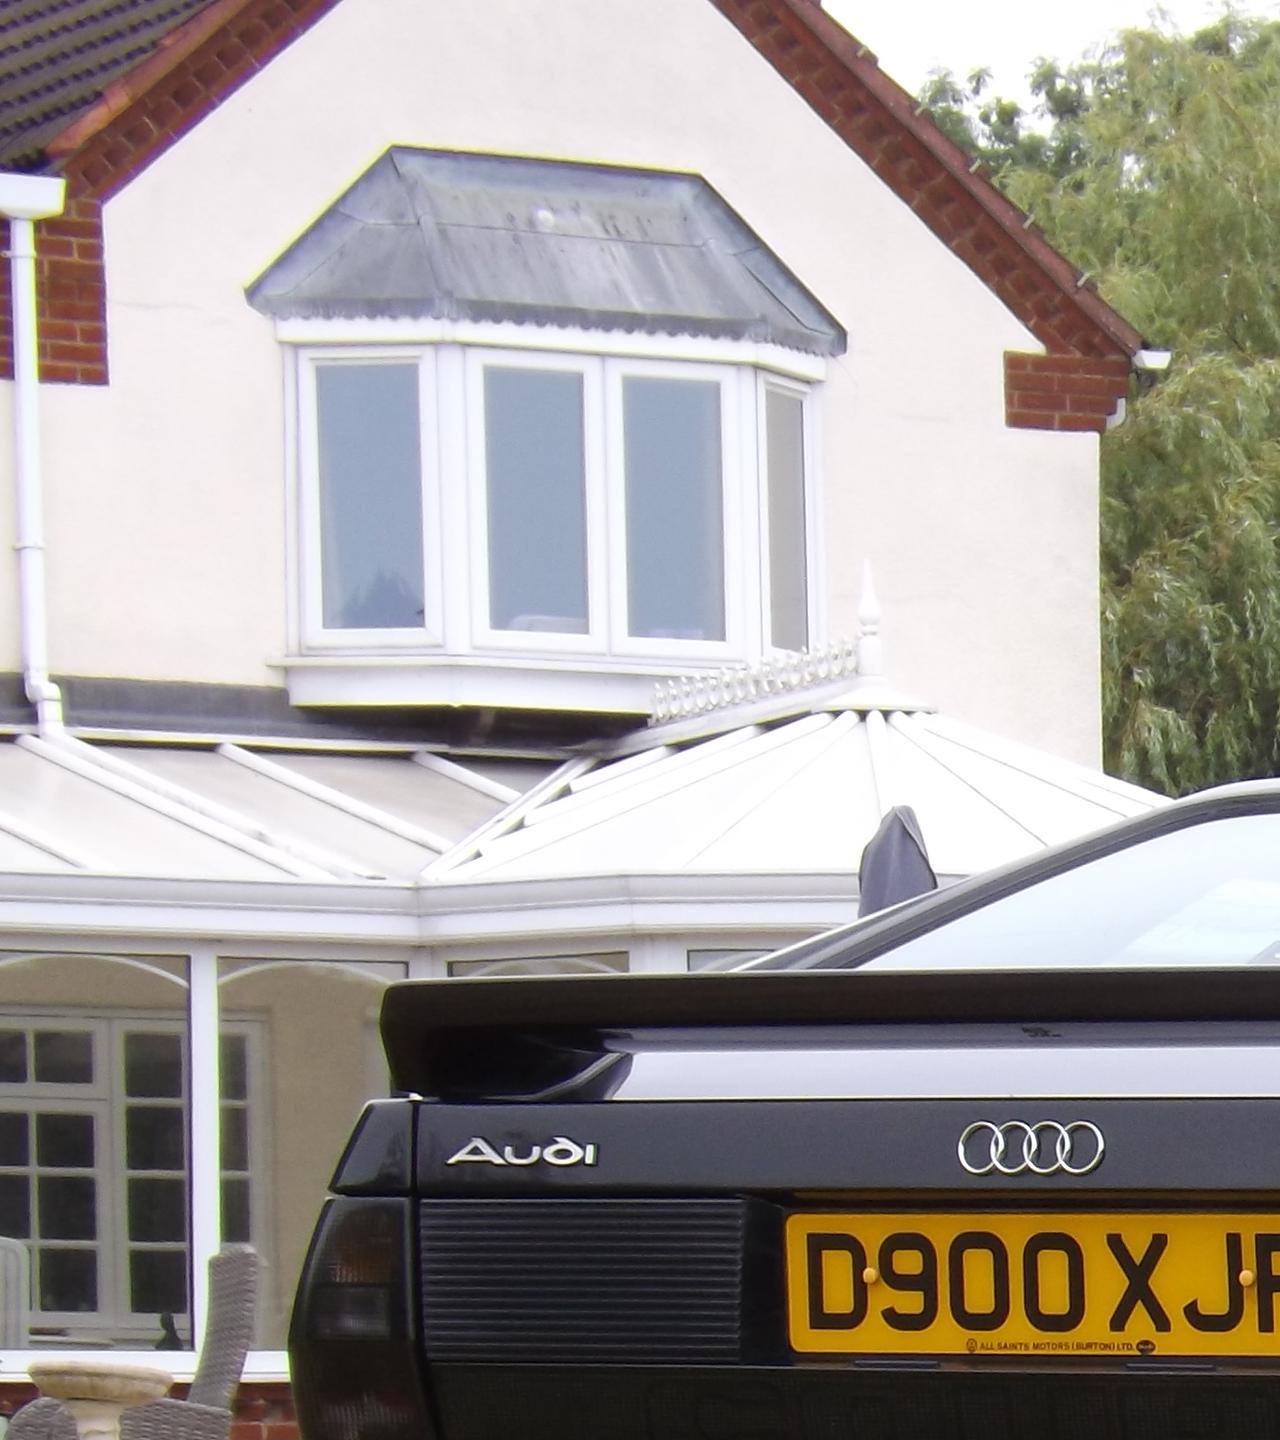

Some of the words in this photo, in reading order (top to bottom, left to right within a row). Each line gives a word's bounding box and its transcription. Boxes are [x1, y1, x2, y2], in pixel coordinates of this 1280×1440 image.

[446, 1136, 598, 1167] Audi
[806, 1231, 1086, 1332] D900
[979, 1341, 995, 1351] ALL
[997, 1341, 1030, 1351] SAINTS
[1032, 1341, 1070, 1351] MOTORS
